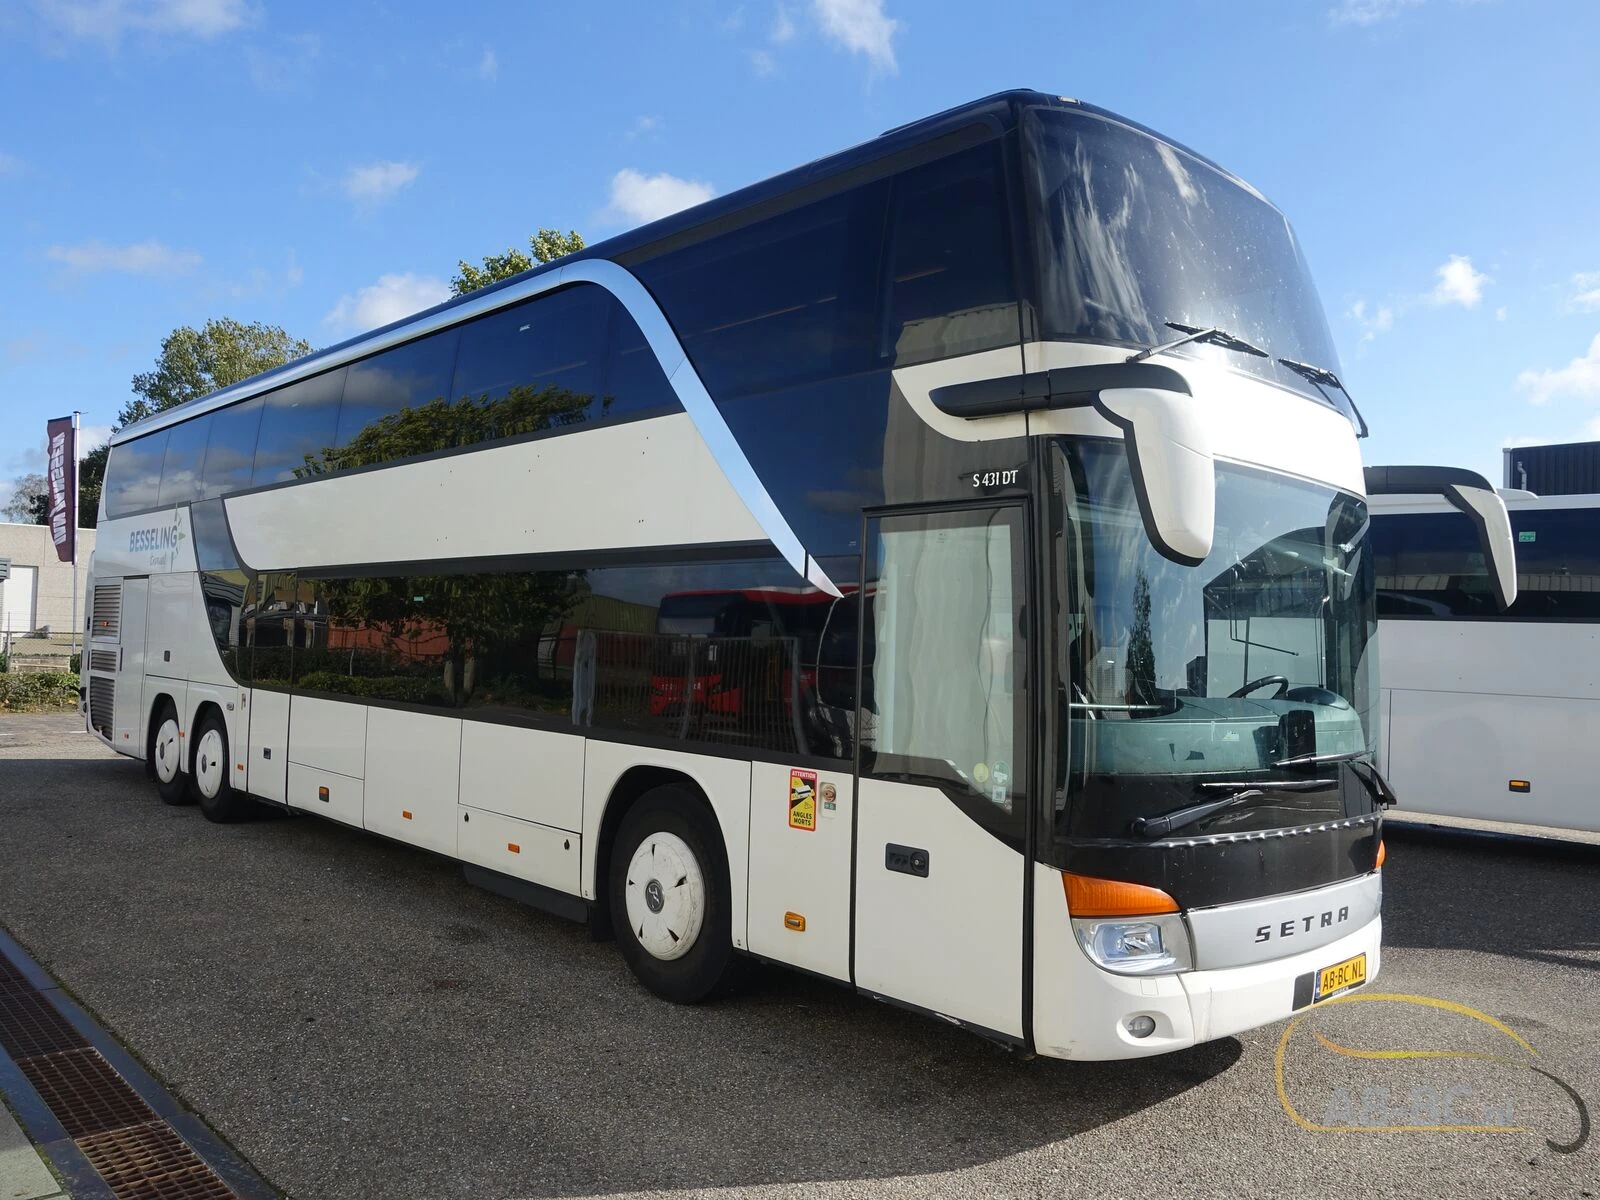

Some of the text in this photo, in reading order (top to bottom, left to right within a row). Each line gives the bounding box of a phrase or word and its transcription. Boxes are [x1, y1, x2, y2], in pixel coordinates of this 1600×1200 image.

[973, 469, 1019, 487] S 431 DT
[129, 525, 178, 552] BESSELING
[792, 770, 817, 780] ATTENTION
[793, 811, 813, 820] ANGLES
[793, 817, 811, 826] MORTS
[1254, 906, 1349, 943] SETRA
